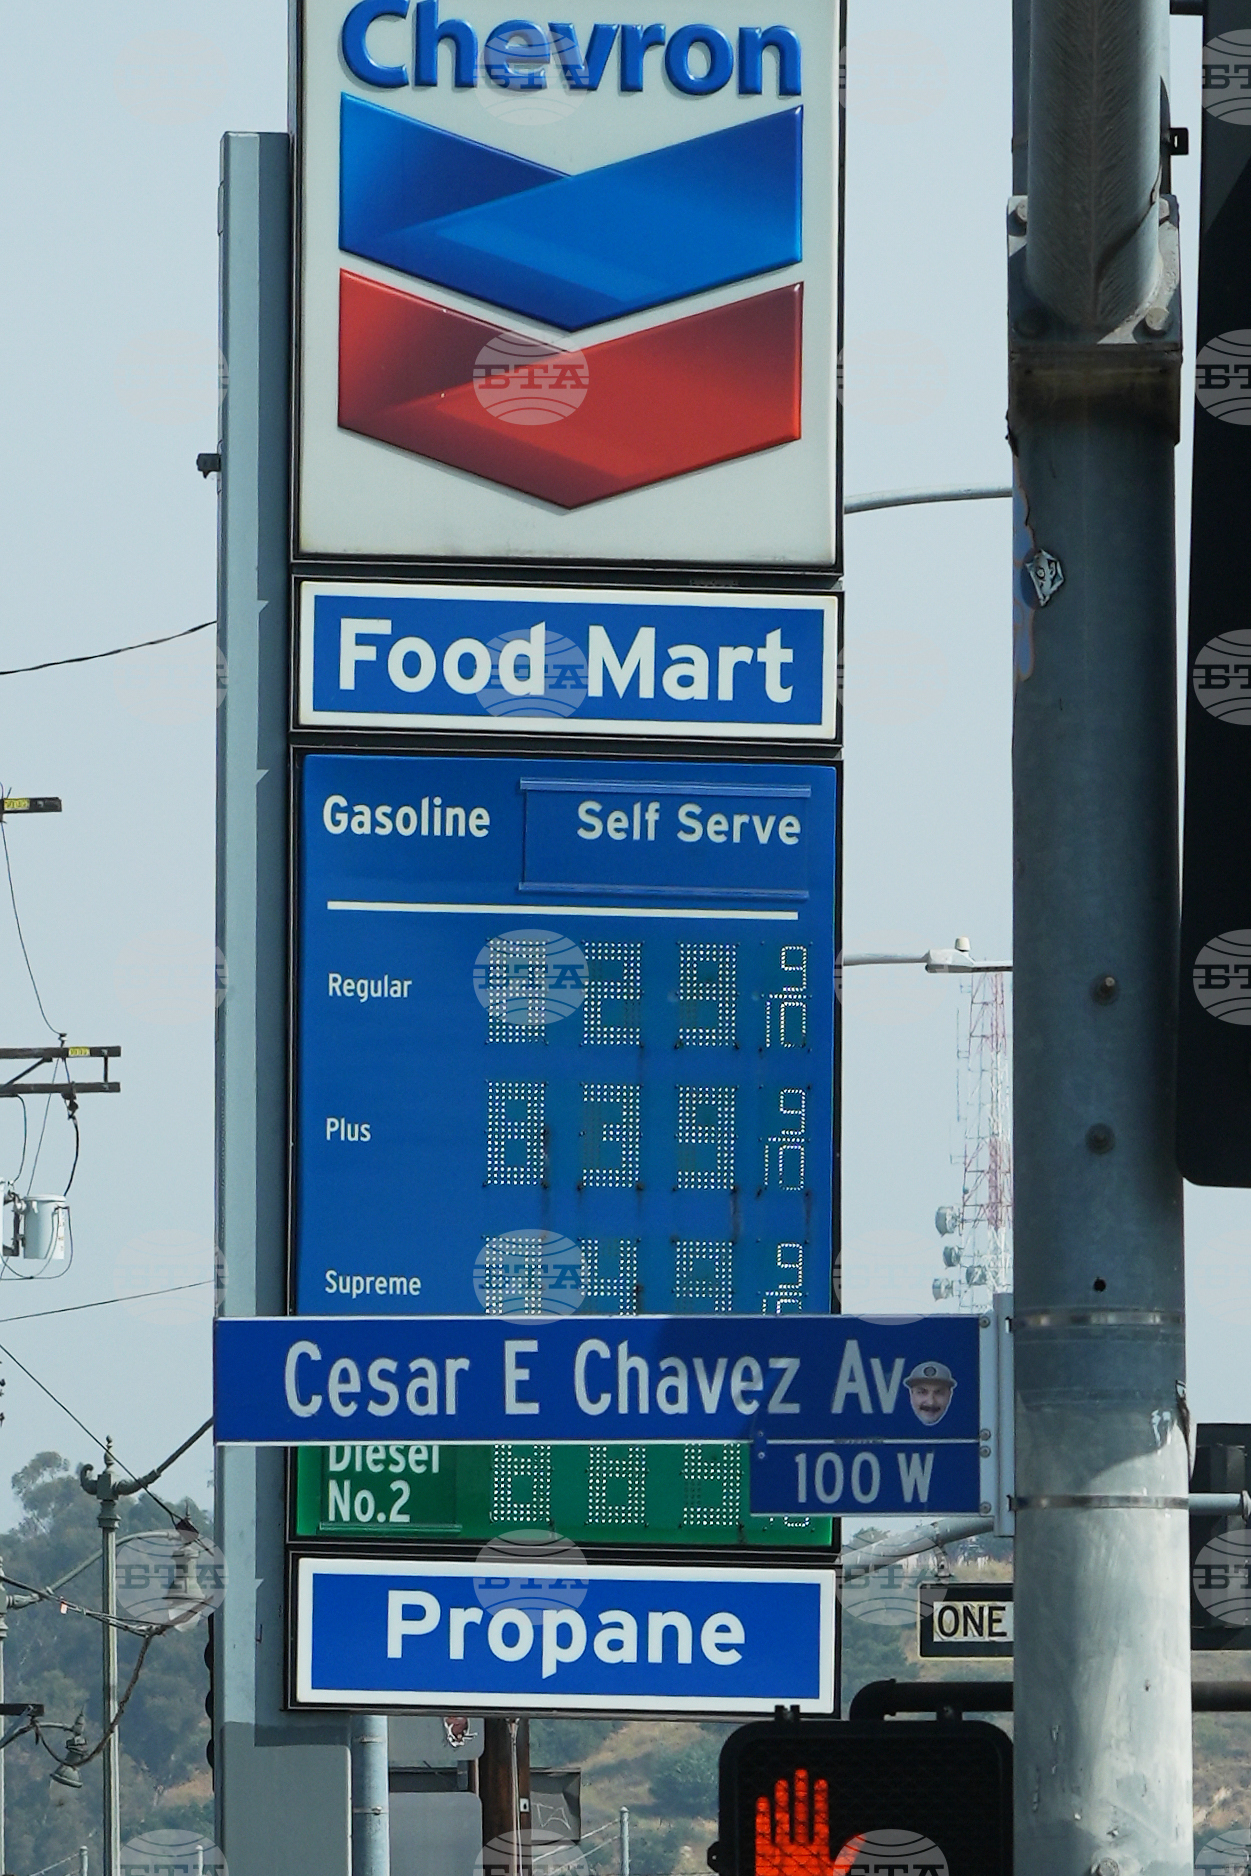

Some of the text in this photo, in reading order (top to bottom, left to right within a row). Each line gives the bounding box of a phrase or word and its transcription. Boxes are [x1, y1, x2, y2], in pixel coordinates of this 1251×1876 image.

[340, 0, 803, 97] Chevron
[339, 617, 795, 704] Food Mart
[323, 794, 801, 846] Gasoline Self Serve
[327, 972, 412, 1004] Regular
[325, 1117, 372, 1142] Plus
[325, 1269, 422, 1299] Supreme
[284, 1338, 906, 1418] Cesar E Chavez Av
[328, 1445, 440, 1475] Diesel
[794, 1452, 935, 1505] 100 W
[328, 1480, 411, 1523] No.2
[386, 1590, 747, 1680] Propane
[937, 1604, 1008, 1638] ONE
